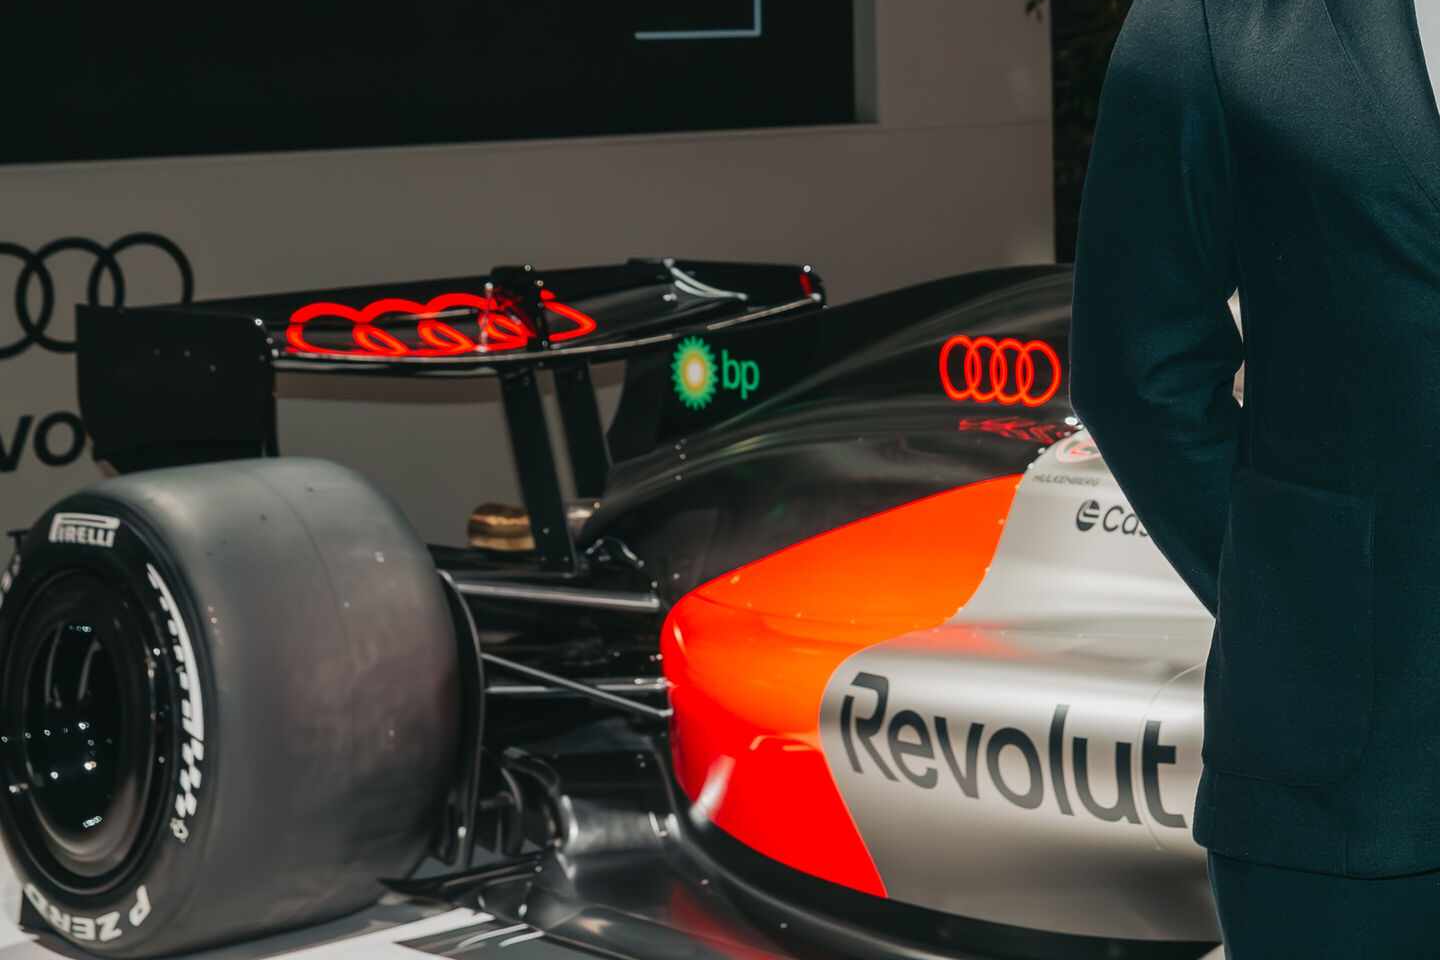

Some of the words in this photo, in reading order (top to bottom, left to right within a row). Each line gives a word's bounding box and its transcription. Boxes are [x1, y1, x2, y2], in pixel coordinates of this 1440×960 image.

[721, 348, 761, 401] bp
[49, 512, 121, 548] PIRELLI
[1102, 504, 1151, 538] Ca
[840, 671, 1188, 829] Revolut
